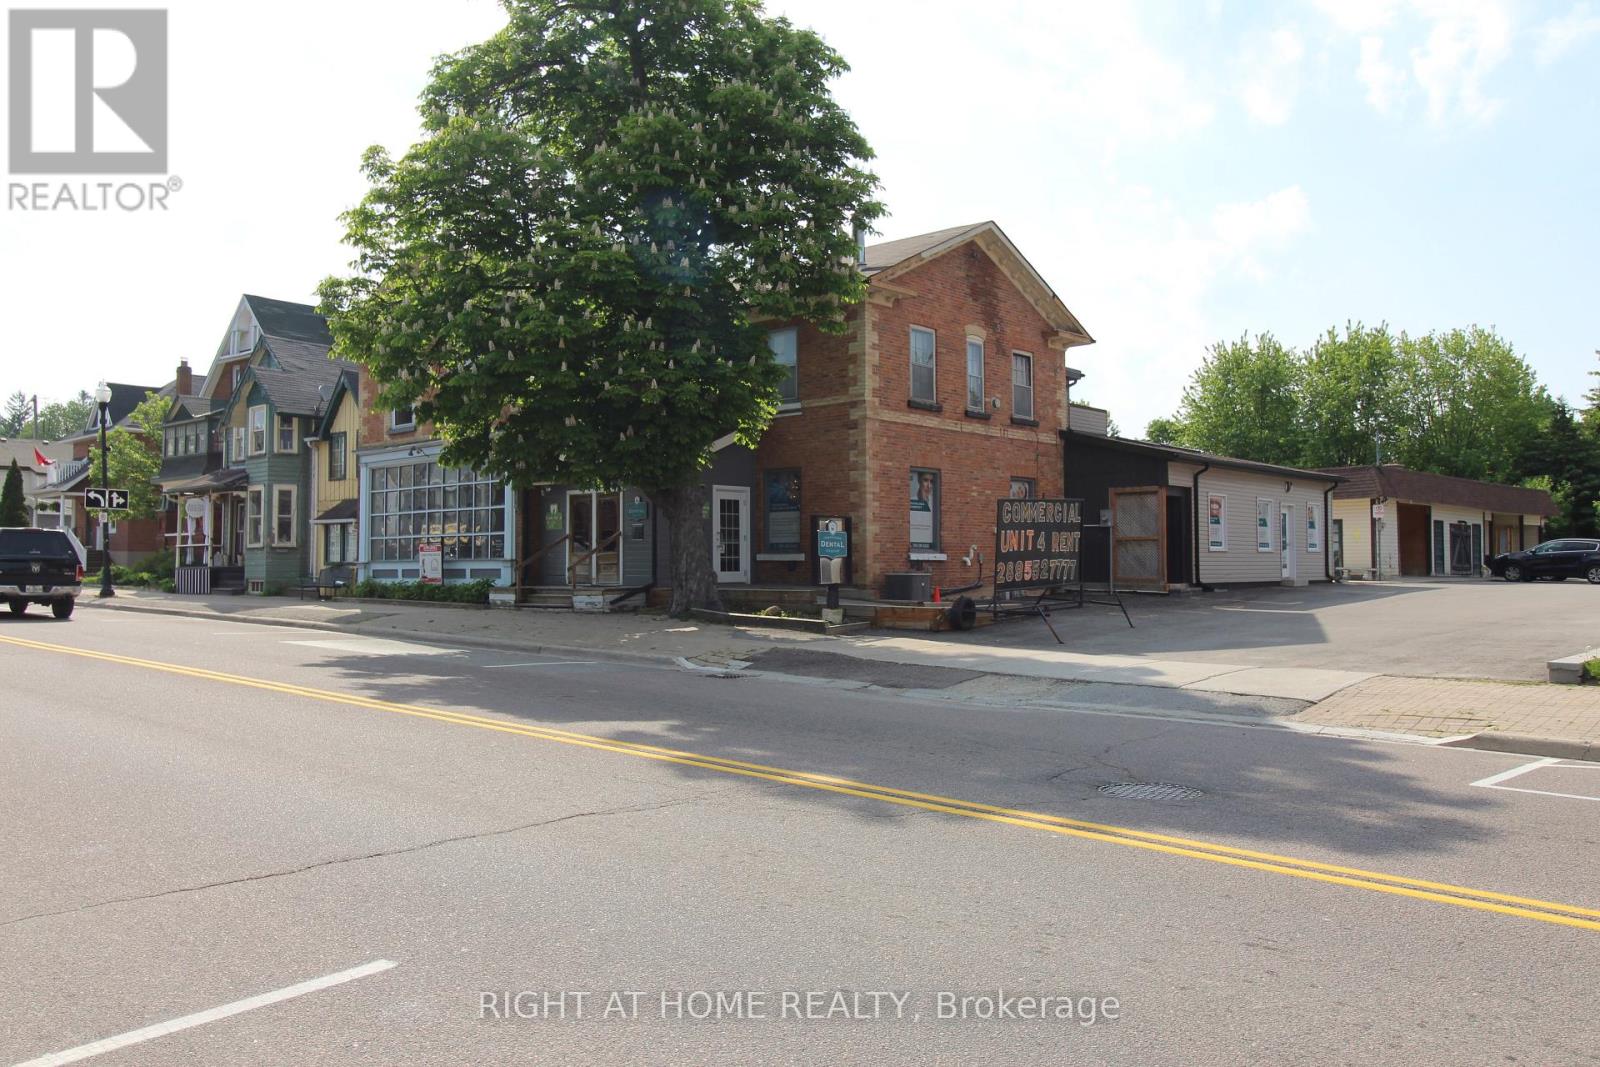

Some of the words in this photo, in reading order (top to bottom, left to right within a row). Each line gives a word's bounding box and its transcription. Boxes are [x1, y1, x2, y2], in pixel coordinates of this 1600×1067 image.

[820, 540, 845, 548] DENTAL
[1000, 529, 1035, 552] UNIT
[1036, 531, 1046, 552] 4
[1051, 531, 1081, 552] RENT
